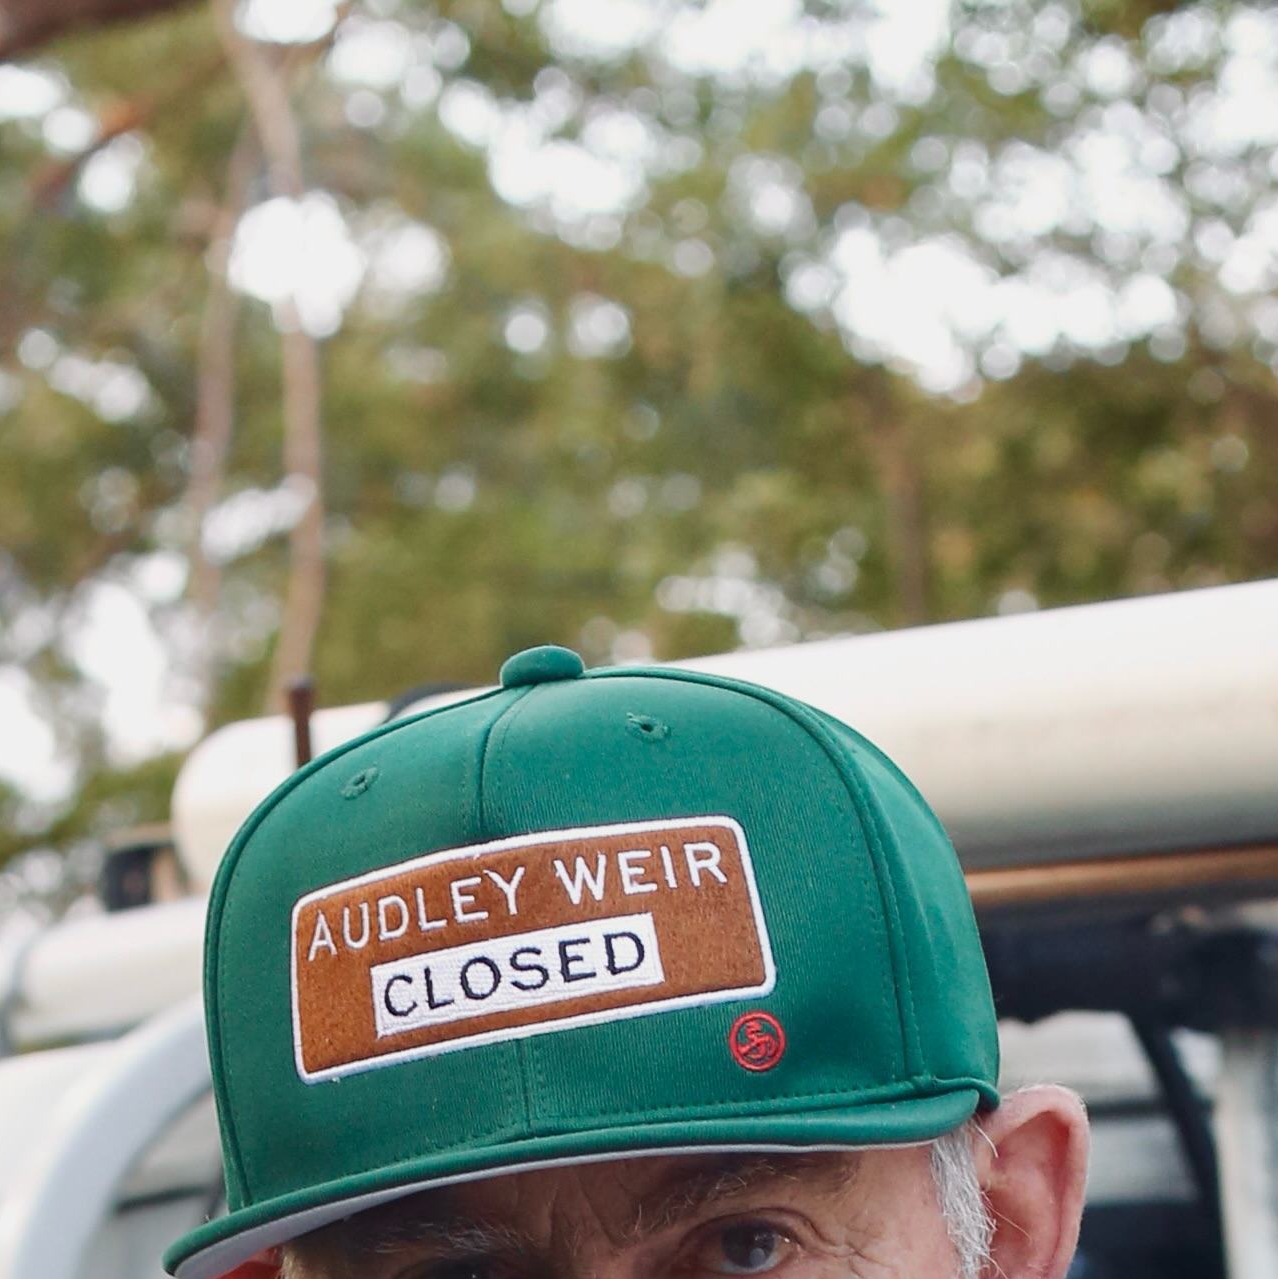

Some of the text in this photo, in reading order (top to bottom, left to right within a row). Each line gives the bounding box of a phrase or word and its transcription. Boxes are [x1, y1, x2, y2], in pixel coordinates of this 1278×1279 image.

[307, 841, 728, 962] AUDLEY WEIR
[382, 930, 646, 1019] CLOSED
